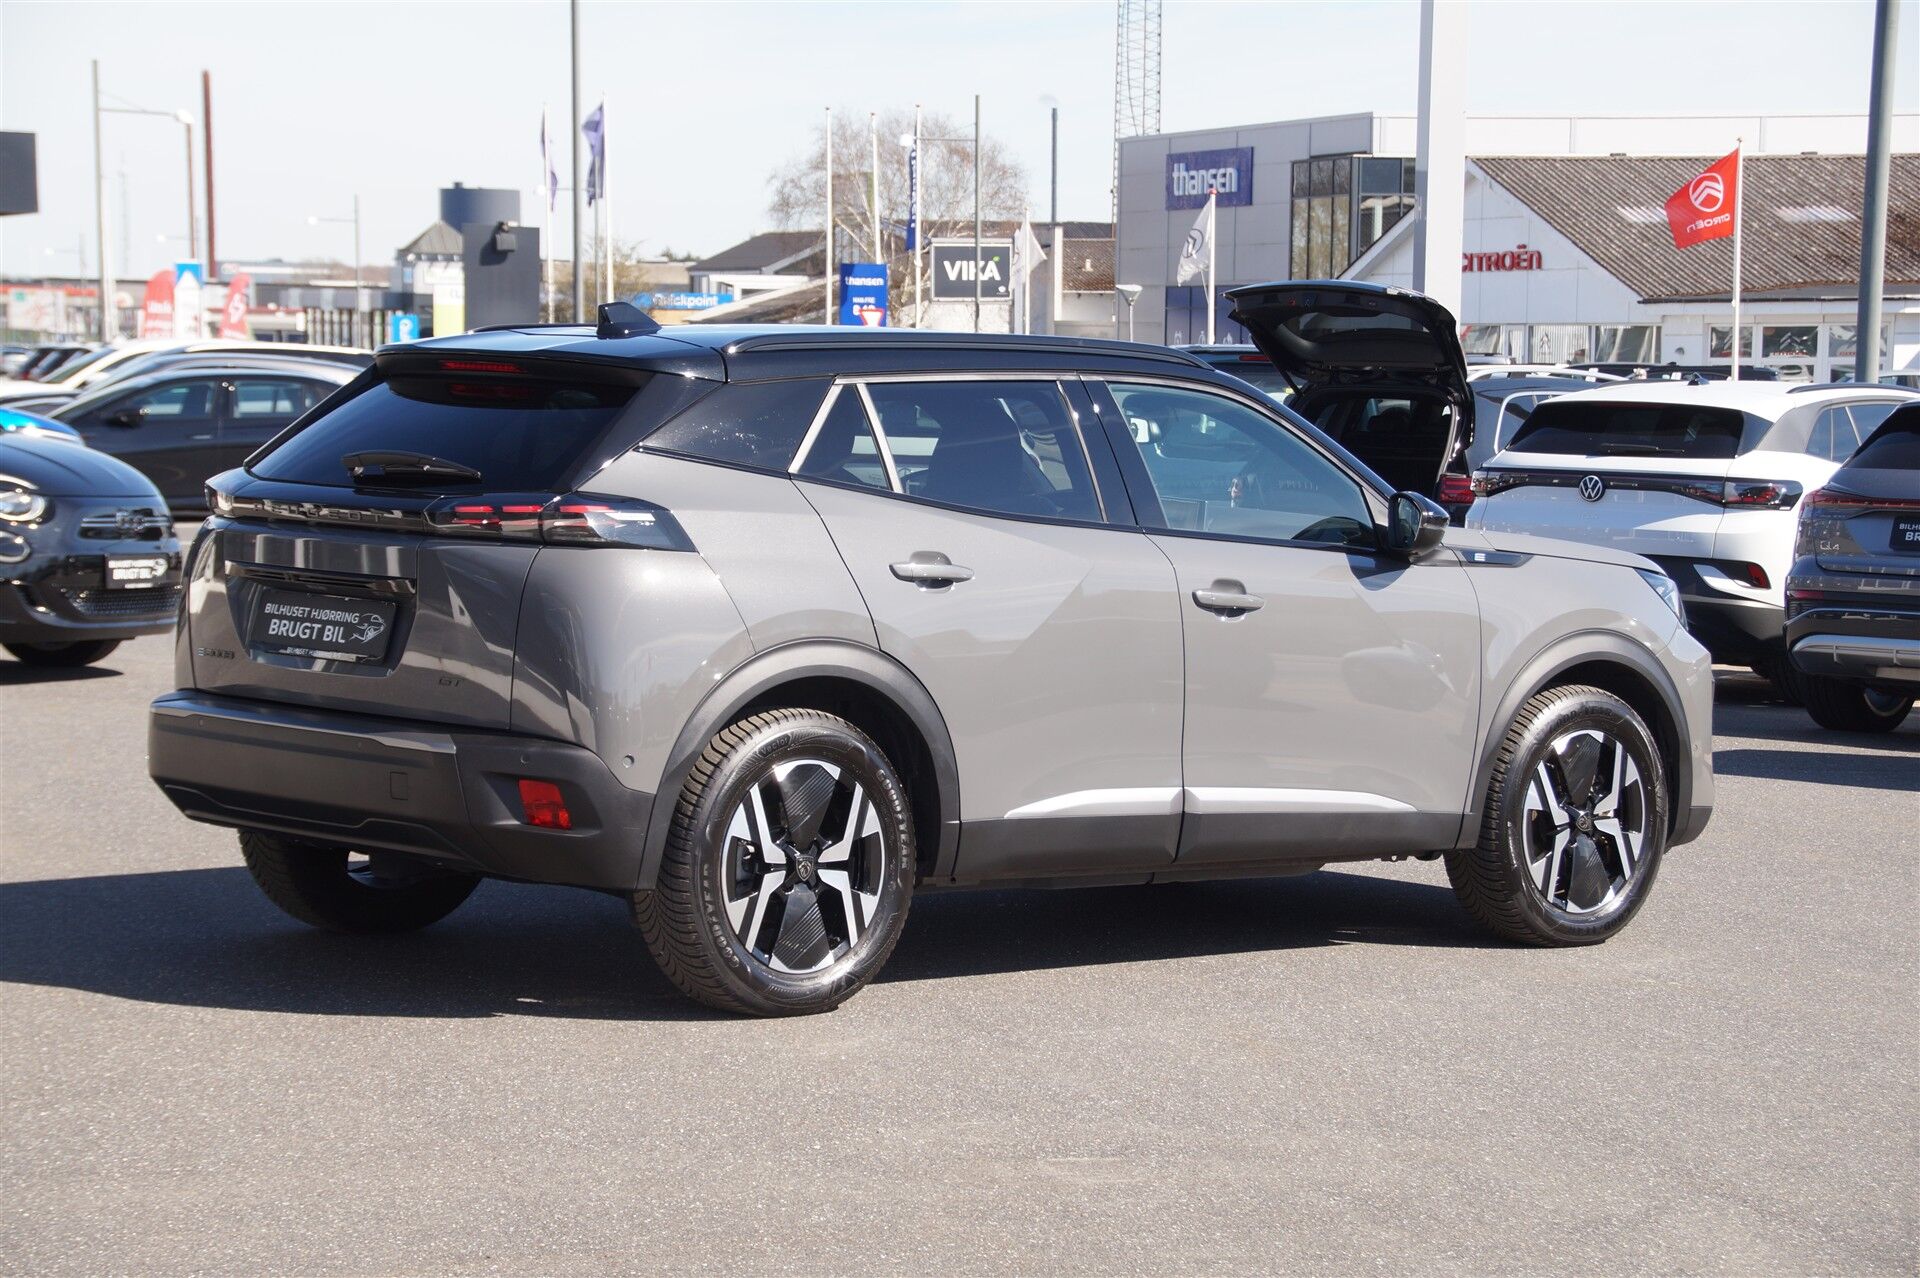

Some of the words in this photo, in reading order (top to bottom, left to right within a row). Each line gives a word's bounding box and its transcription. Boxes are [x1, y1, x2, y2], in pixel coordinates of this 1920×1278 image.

[1172, 163, 1238, 196] thansen
[845, 276, 884, 286] thansen
[943, 260, 1001, 281] VIKA
[1899, 523, 1920, 531] BILH
[264, 603, 310, 618] BILHUSET
[311, 608, 360, 624] HJØRRING
[268, 619, 322, 640] BRUGT
[322, 625, 346, 643] BIL
